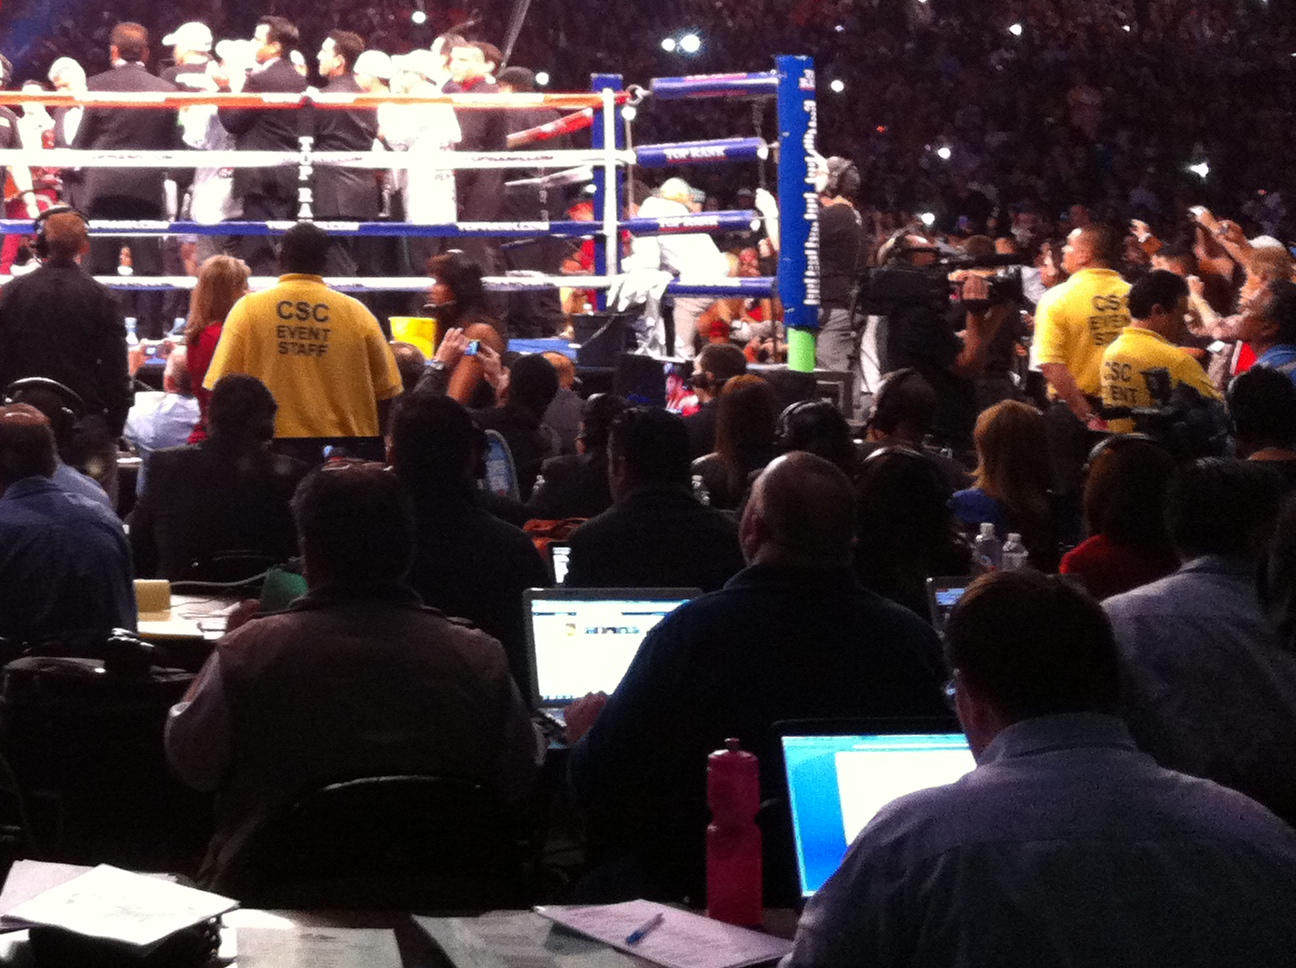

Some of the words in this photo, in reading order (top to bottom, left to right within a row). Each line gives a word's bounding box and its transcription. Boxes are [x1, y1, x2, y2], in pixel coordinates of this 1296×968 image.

[276, 300, 330, 322] CSC
[276, 325, 331, 342] EVENT
[278, 341, 329, 357] STAFF
